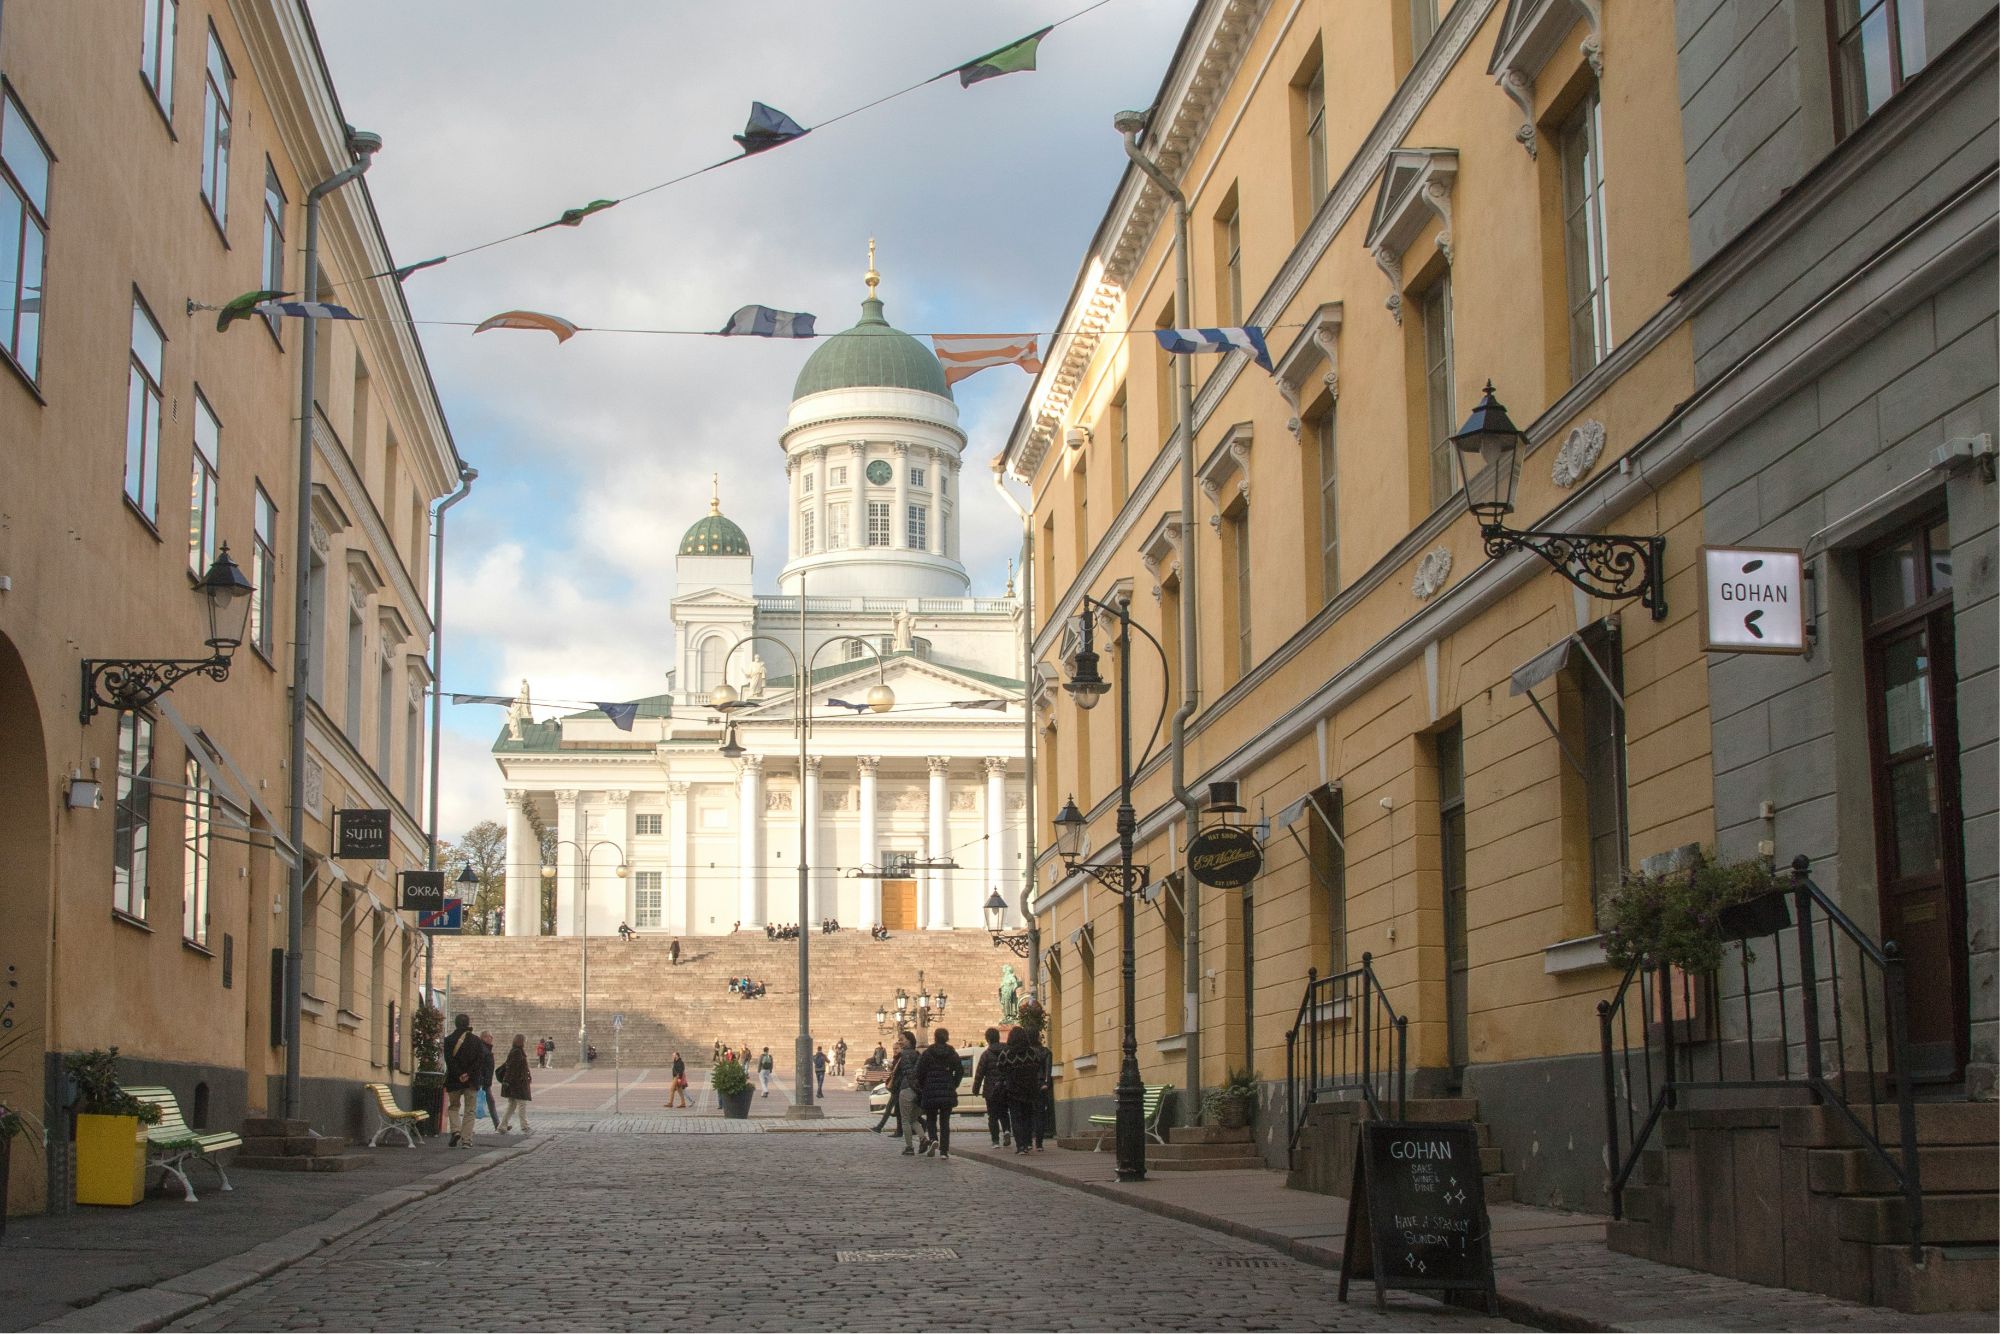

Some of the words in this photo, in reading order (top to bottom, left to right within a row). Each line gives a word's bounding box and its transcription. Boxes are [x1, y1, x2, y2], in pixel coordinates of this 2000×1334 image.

[1721, 582, 1787, 603] GOHAN
[1207, 833, 1220, 841] HAT
[1221, 832, 1238, 840] SHOP
[407, 885, 441, 897] OKRA
[1390, 1141, 1452, 1160] GOHAN
[1414, 1183, 1436, 1193] DINE
[1394, 1214, 1419, 1230] HAVE
[1403, 1230, 1450, 1248] SUNDAY
